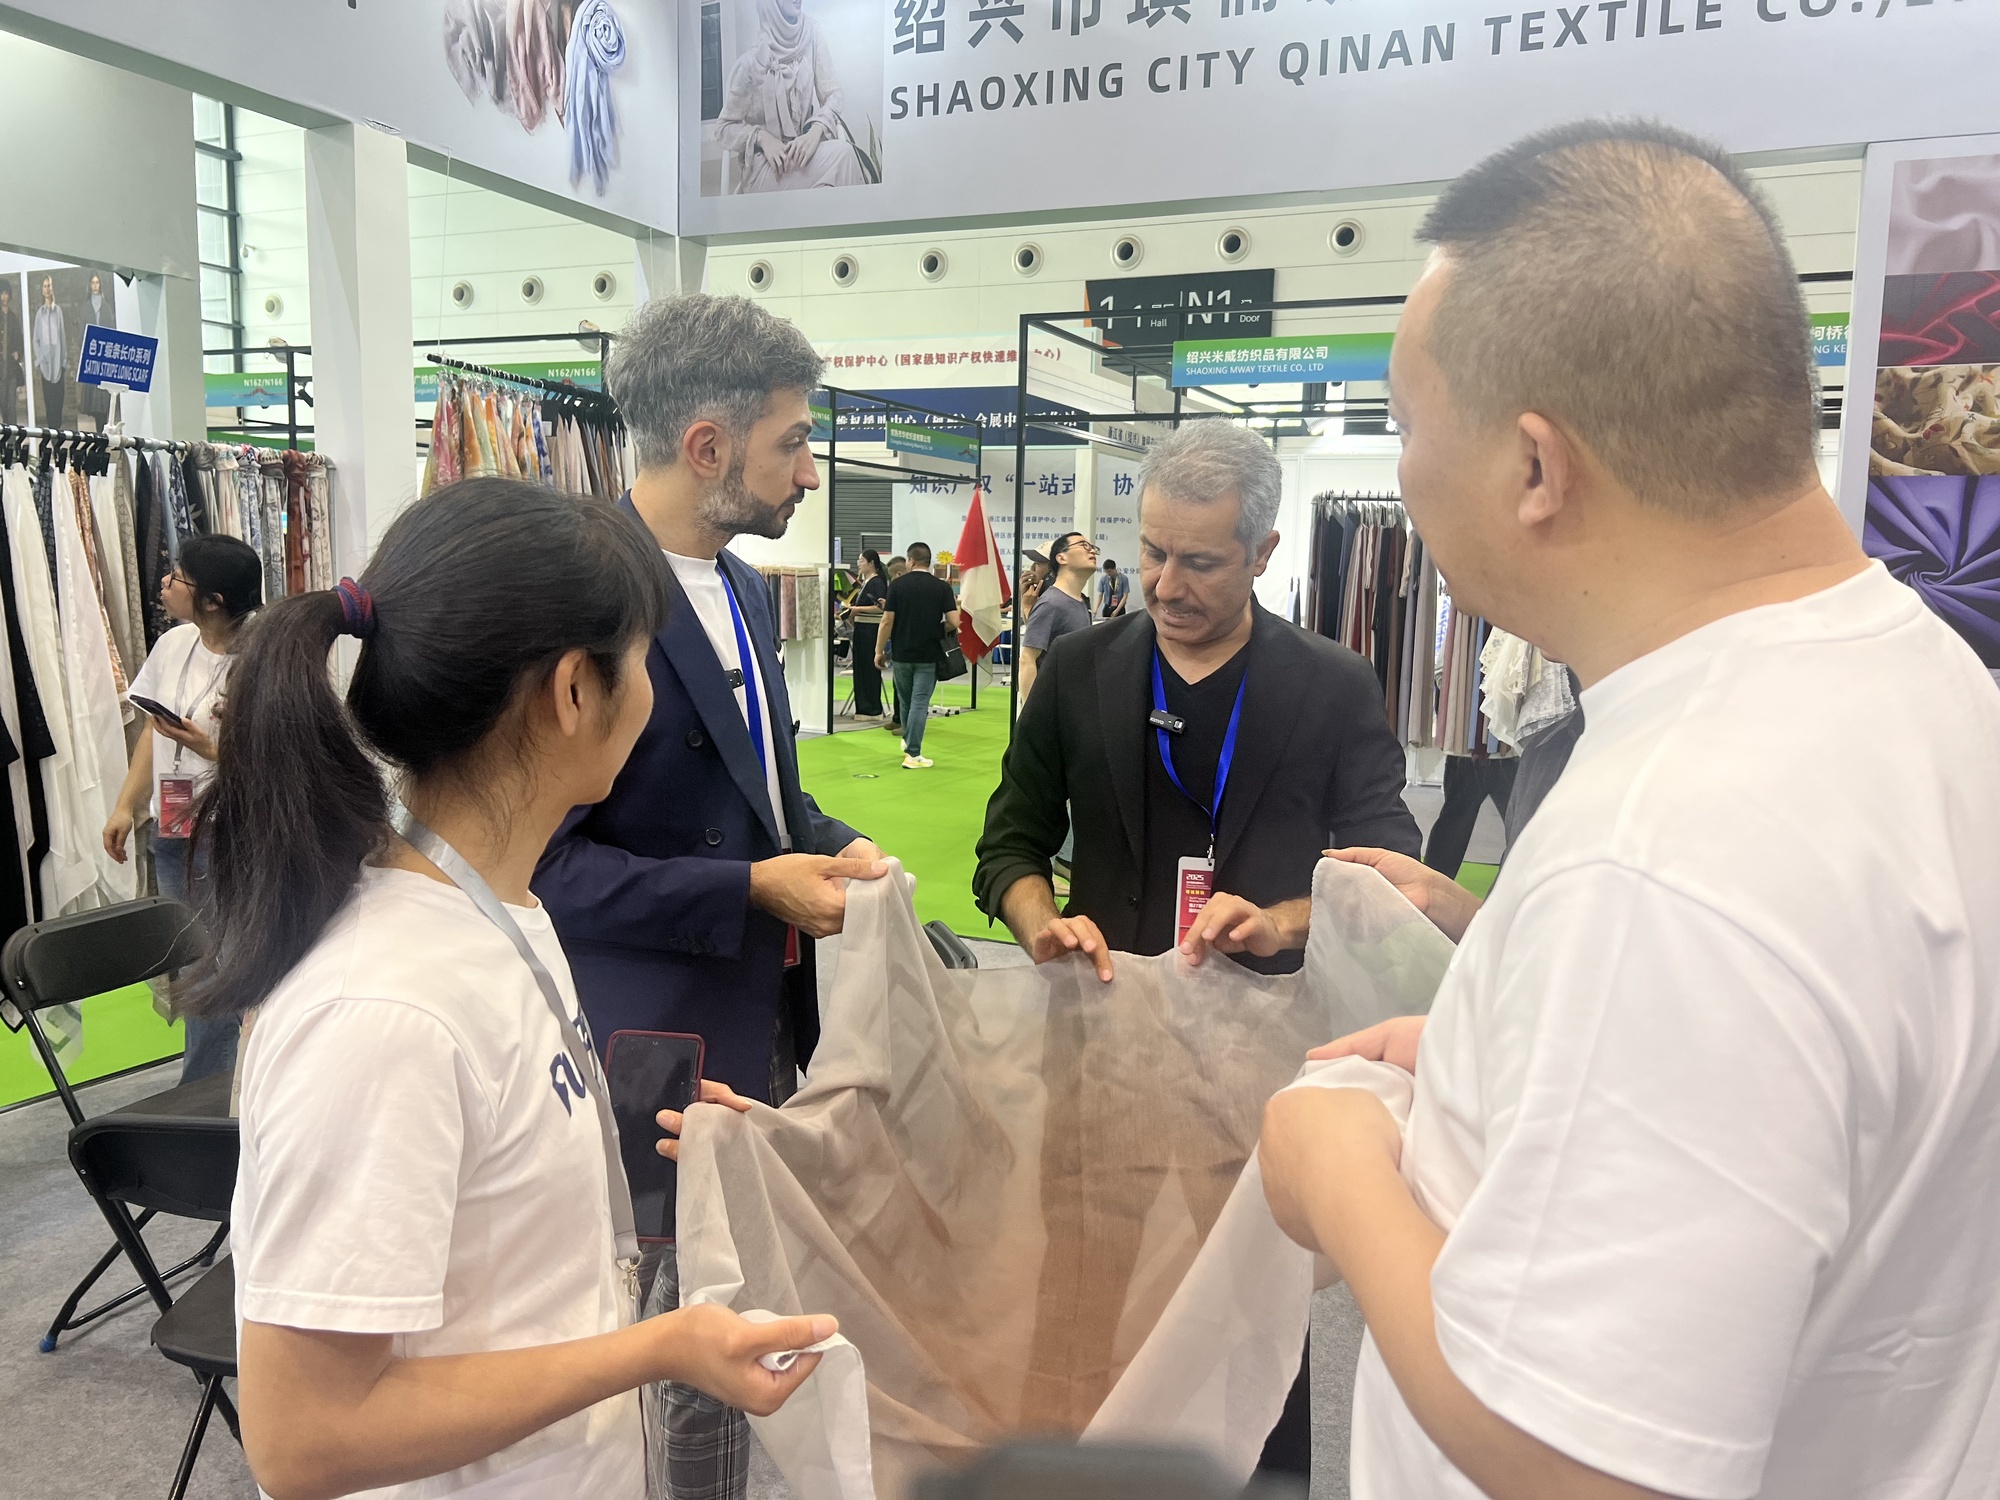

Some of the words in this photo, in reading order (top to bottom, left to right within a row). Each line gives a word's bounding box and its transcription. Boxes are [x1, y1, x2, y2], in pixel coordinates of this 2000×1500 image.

[890, 61, 1123, 120] SHAOXING
[1148, 46, 1255, 93] CITY
[1278, 21, 1456, 86] QINAN
[1483, 0, 1722, 56] TEXTILE
[1187, 289, 1231, 325] N1
[1151, 319, 1168, 327] Hall
[1240, 314, 1260, 323] Door
[1186, 346, 1329, 364] 绍兴米威纺织品有限公司
[84, 359, 100, 375] SATIN
[100, 362, 118, 378] STRIPE
[117, 365, 133, 381] LONG
[131, 367, 149, 383] SCARF
[547, 367, 596, 378] N162/N166
[1185, 366, 1228, 376] SHAOXING
[1229, 365, 1256, 374] MWAY
[1257, 364, 1288, 373] TEXTILE
[1308, 362, 1324, 371] LTD
[243, 378, 283, 387] N162/N166
[1186, 873, 1204, 881] 2025
